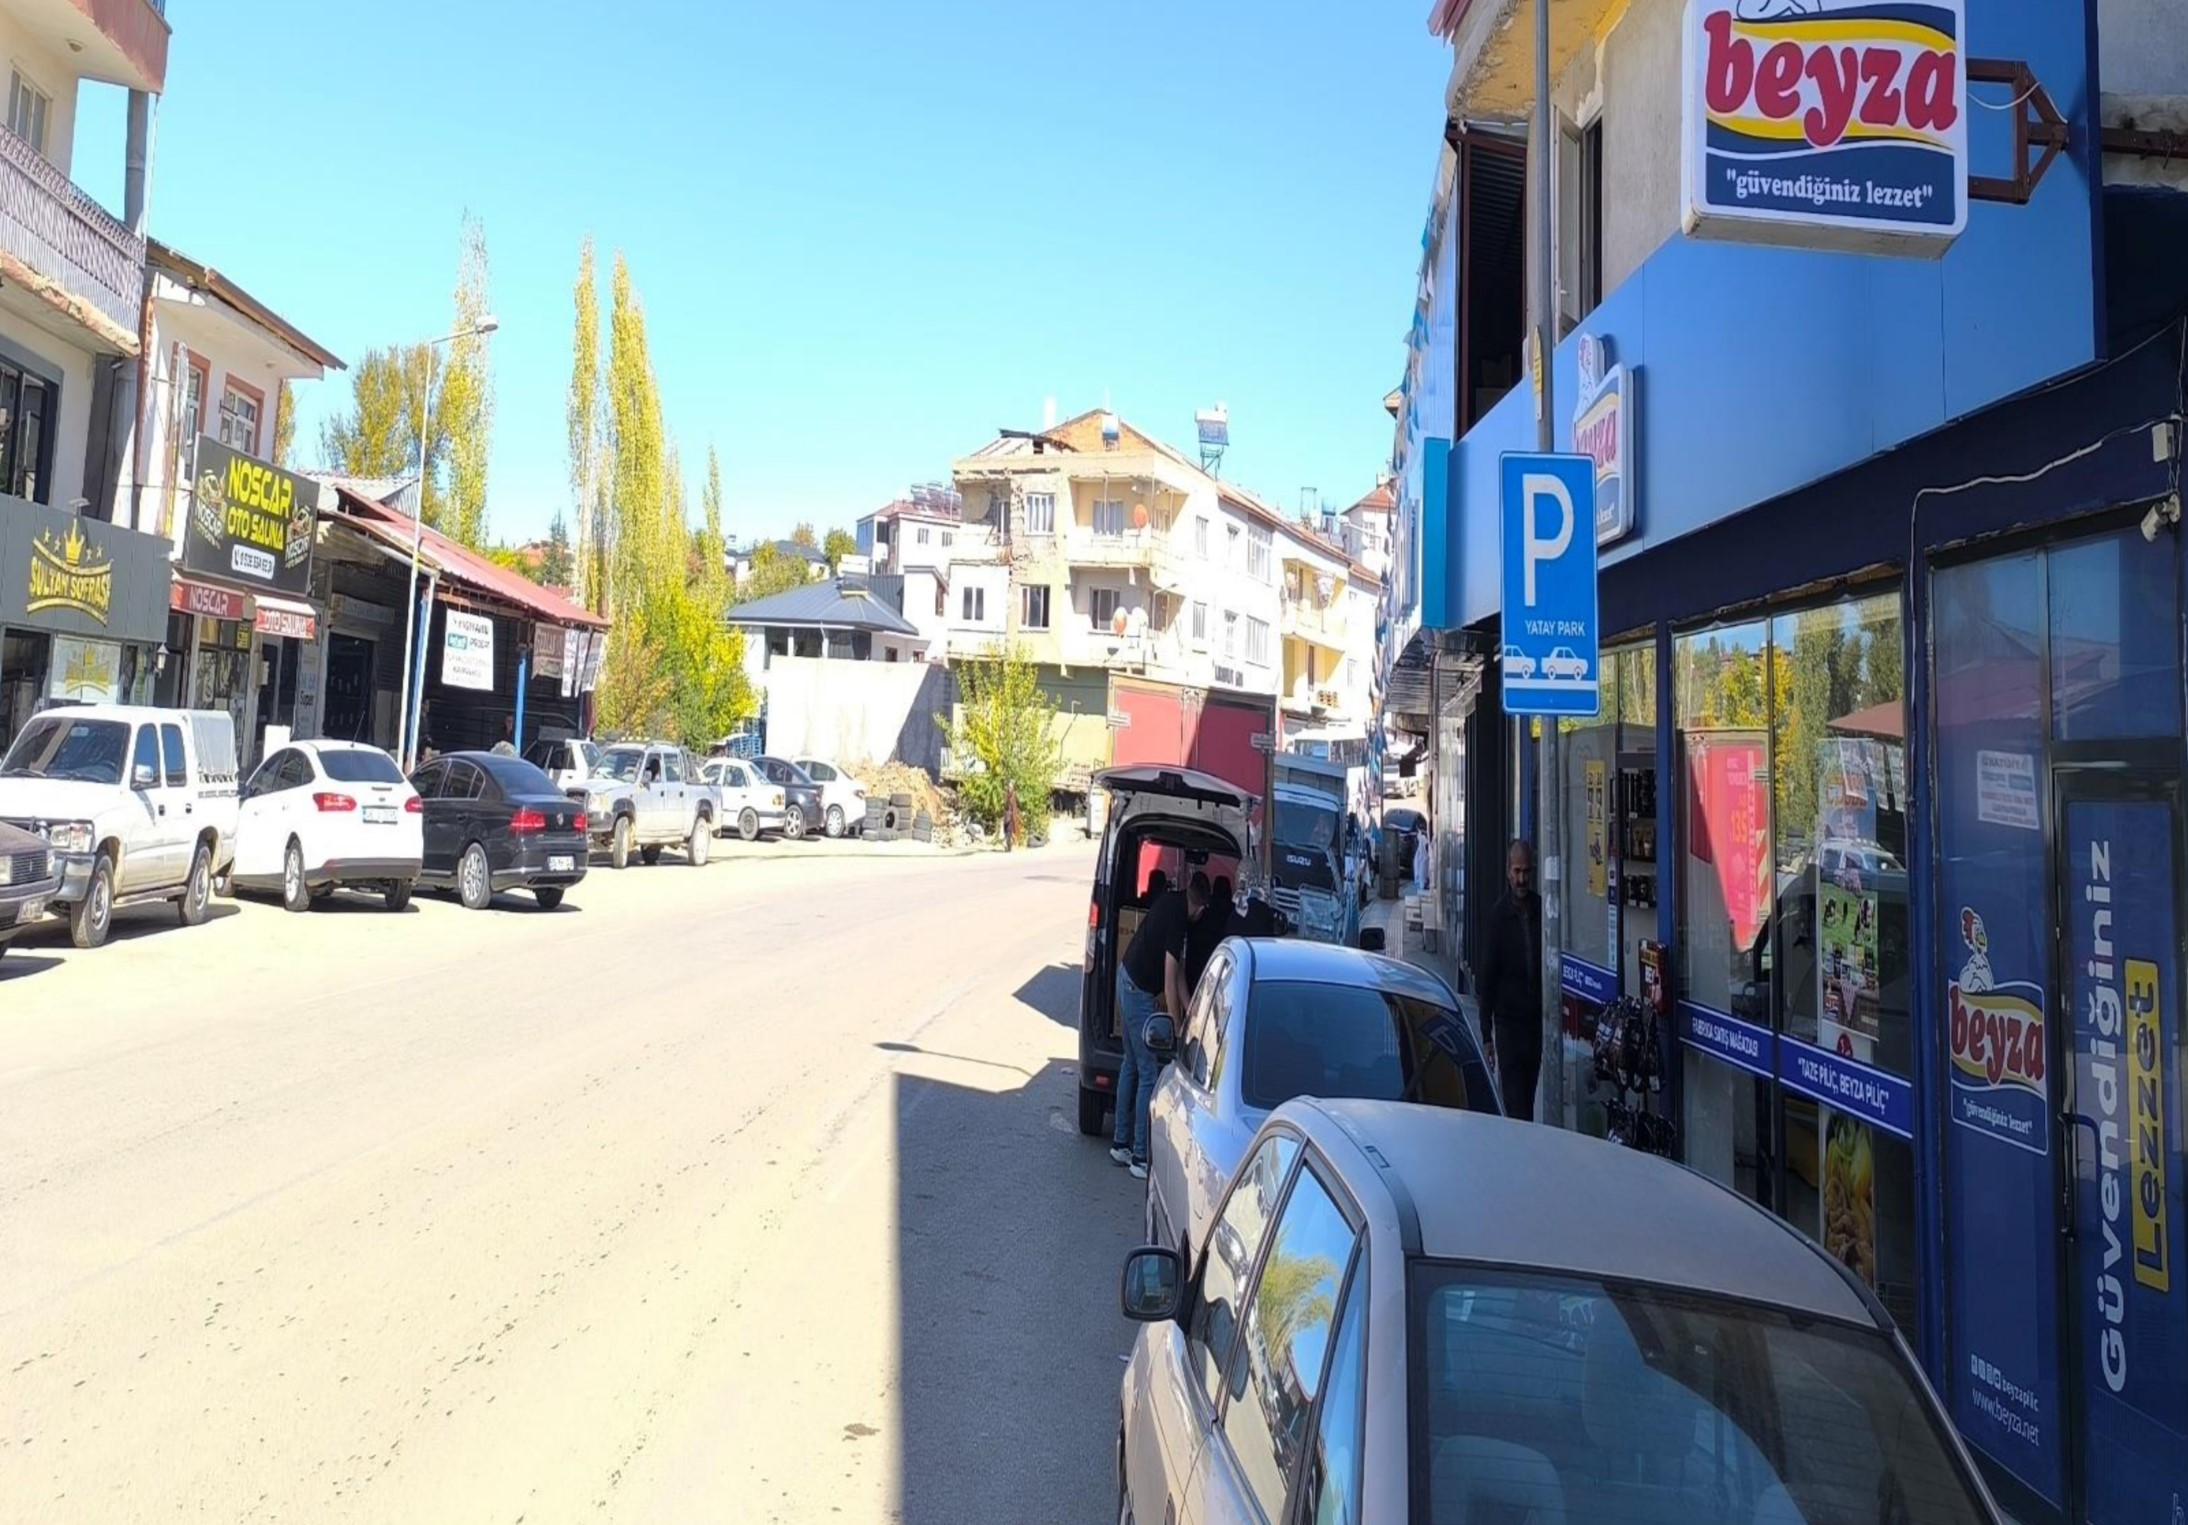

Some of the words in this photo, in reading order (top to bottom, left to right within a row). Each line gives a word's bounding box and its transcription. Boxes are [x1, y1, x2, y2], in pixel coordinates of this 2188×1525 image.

[1704, 10, 1957, 147] beyza
[1726, 168, 1861, 206] "güvendiğiniz
[1866, 181, 1933, 208] lezzet"
[228, 456, 292, 518] NOSCAR
[227, 506, 250, 538] OTO
[250, 514, 284, 550] SAUNA
[1522, 473, 1574, 607] P
[30, 556, 69, 598] SULTAN
[189, 586, 229, 616] NOSCAR
[264, 610, 280, 632] OTO
[281, 613, 307, 637] SAUNA
[1525, 619, 1556, 636] YATAY
[1557, 620, 1586, 637] PARK
[1286, 854, 1312, 867] ISUZU
[1949, 985, 2045, 1085] beyza
[1840, 1073, 1865, 1102] BEYZA
[2086, 841, 2126, 1392] Güvendiğiniz
[2128, 981, 2163, 1273] Lezzet
[1972, 1387, 2040, 1446] www.beyza.net
